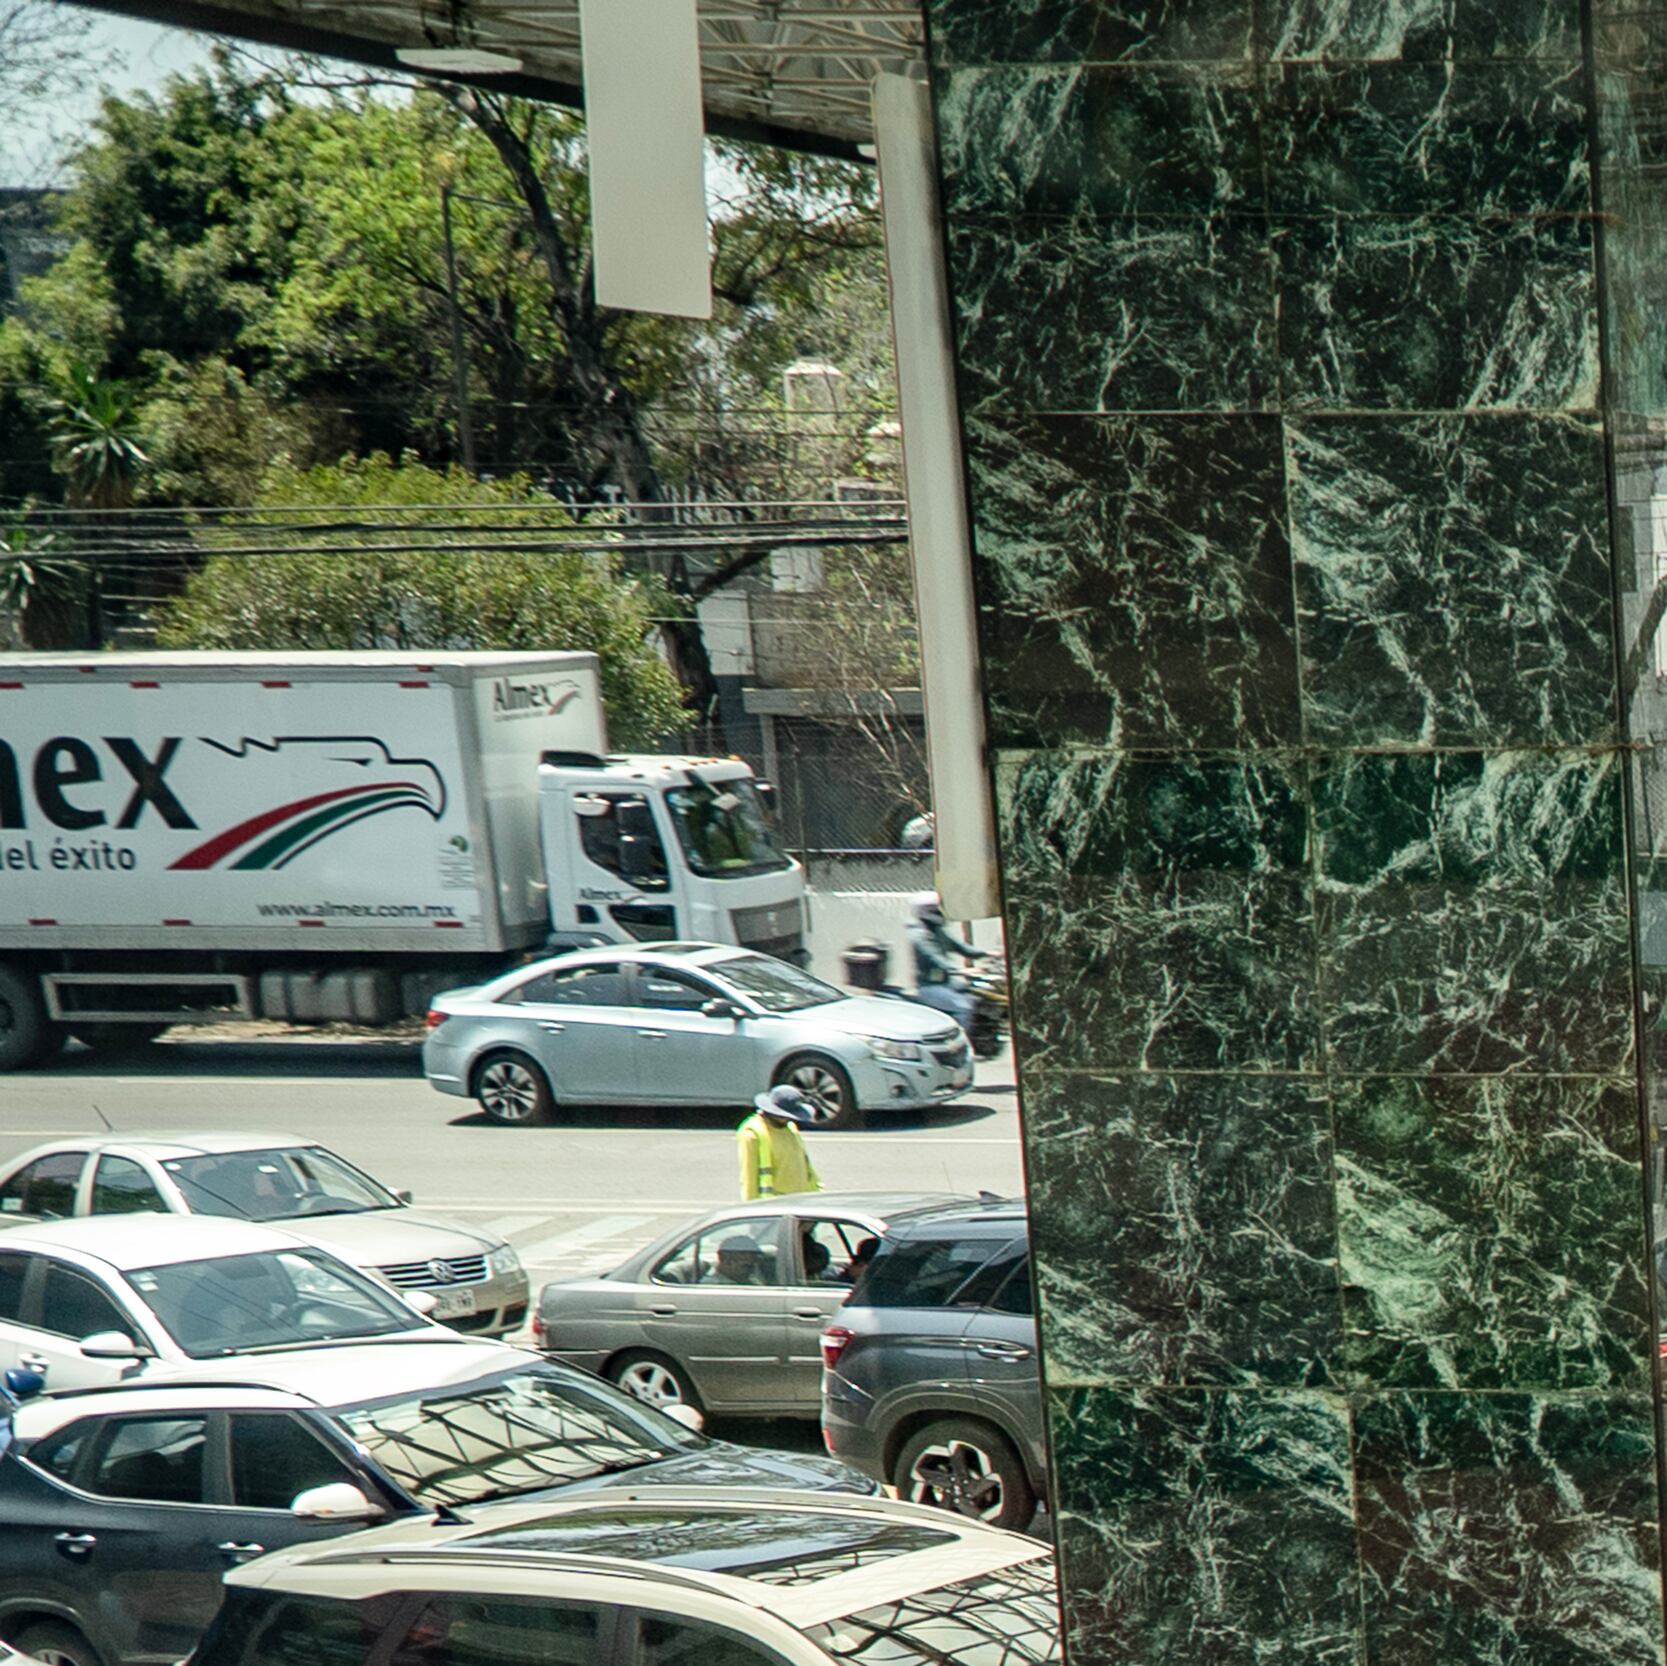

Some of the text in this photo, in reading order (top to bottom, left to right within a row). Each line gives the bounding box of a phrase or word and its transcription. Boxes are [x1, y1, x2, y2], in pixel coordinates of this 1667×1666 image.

[494, 678, 550, 713] Almex
[0, 837, 136, 870] el éxito
[256, 900, 456, 917] www.almex.com.mx
